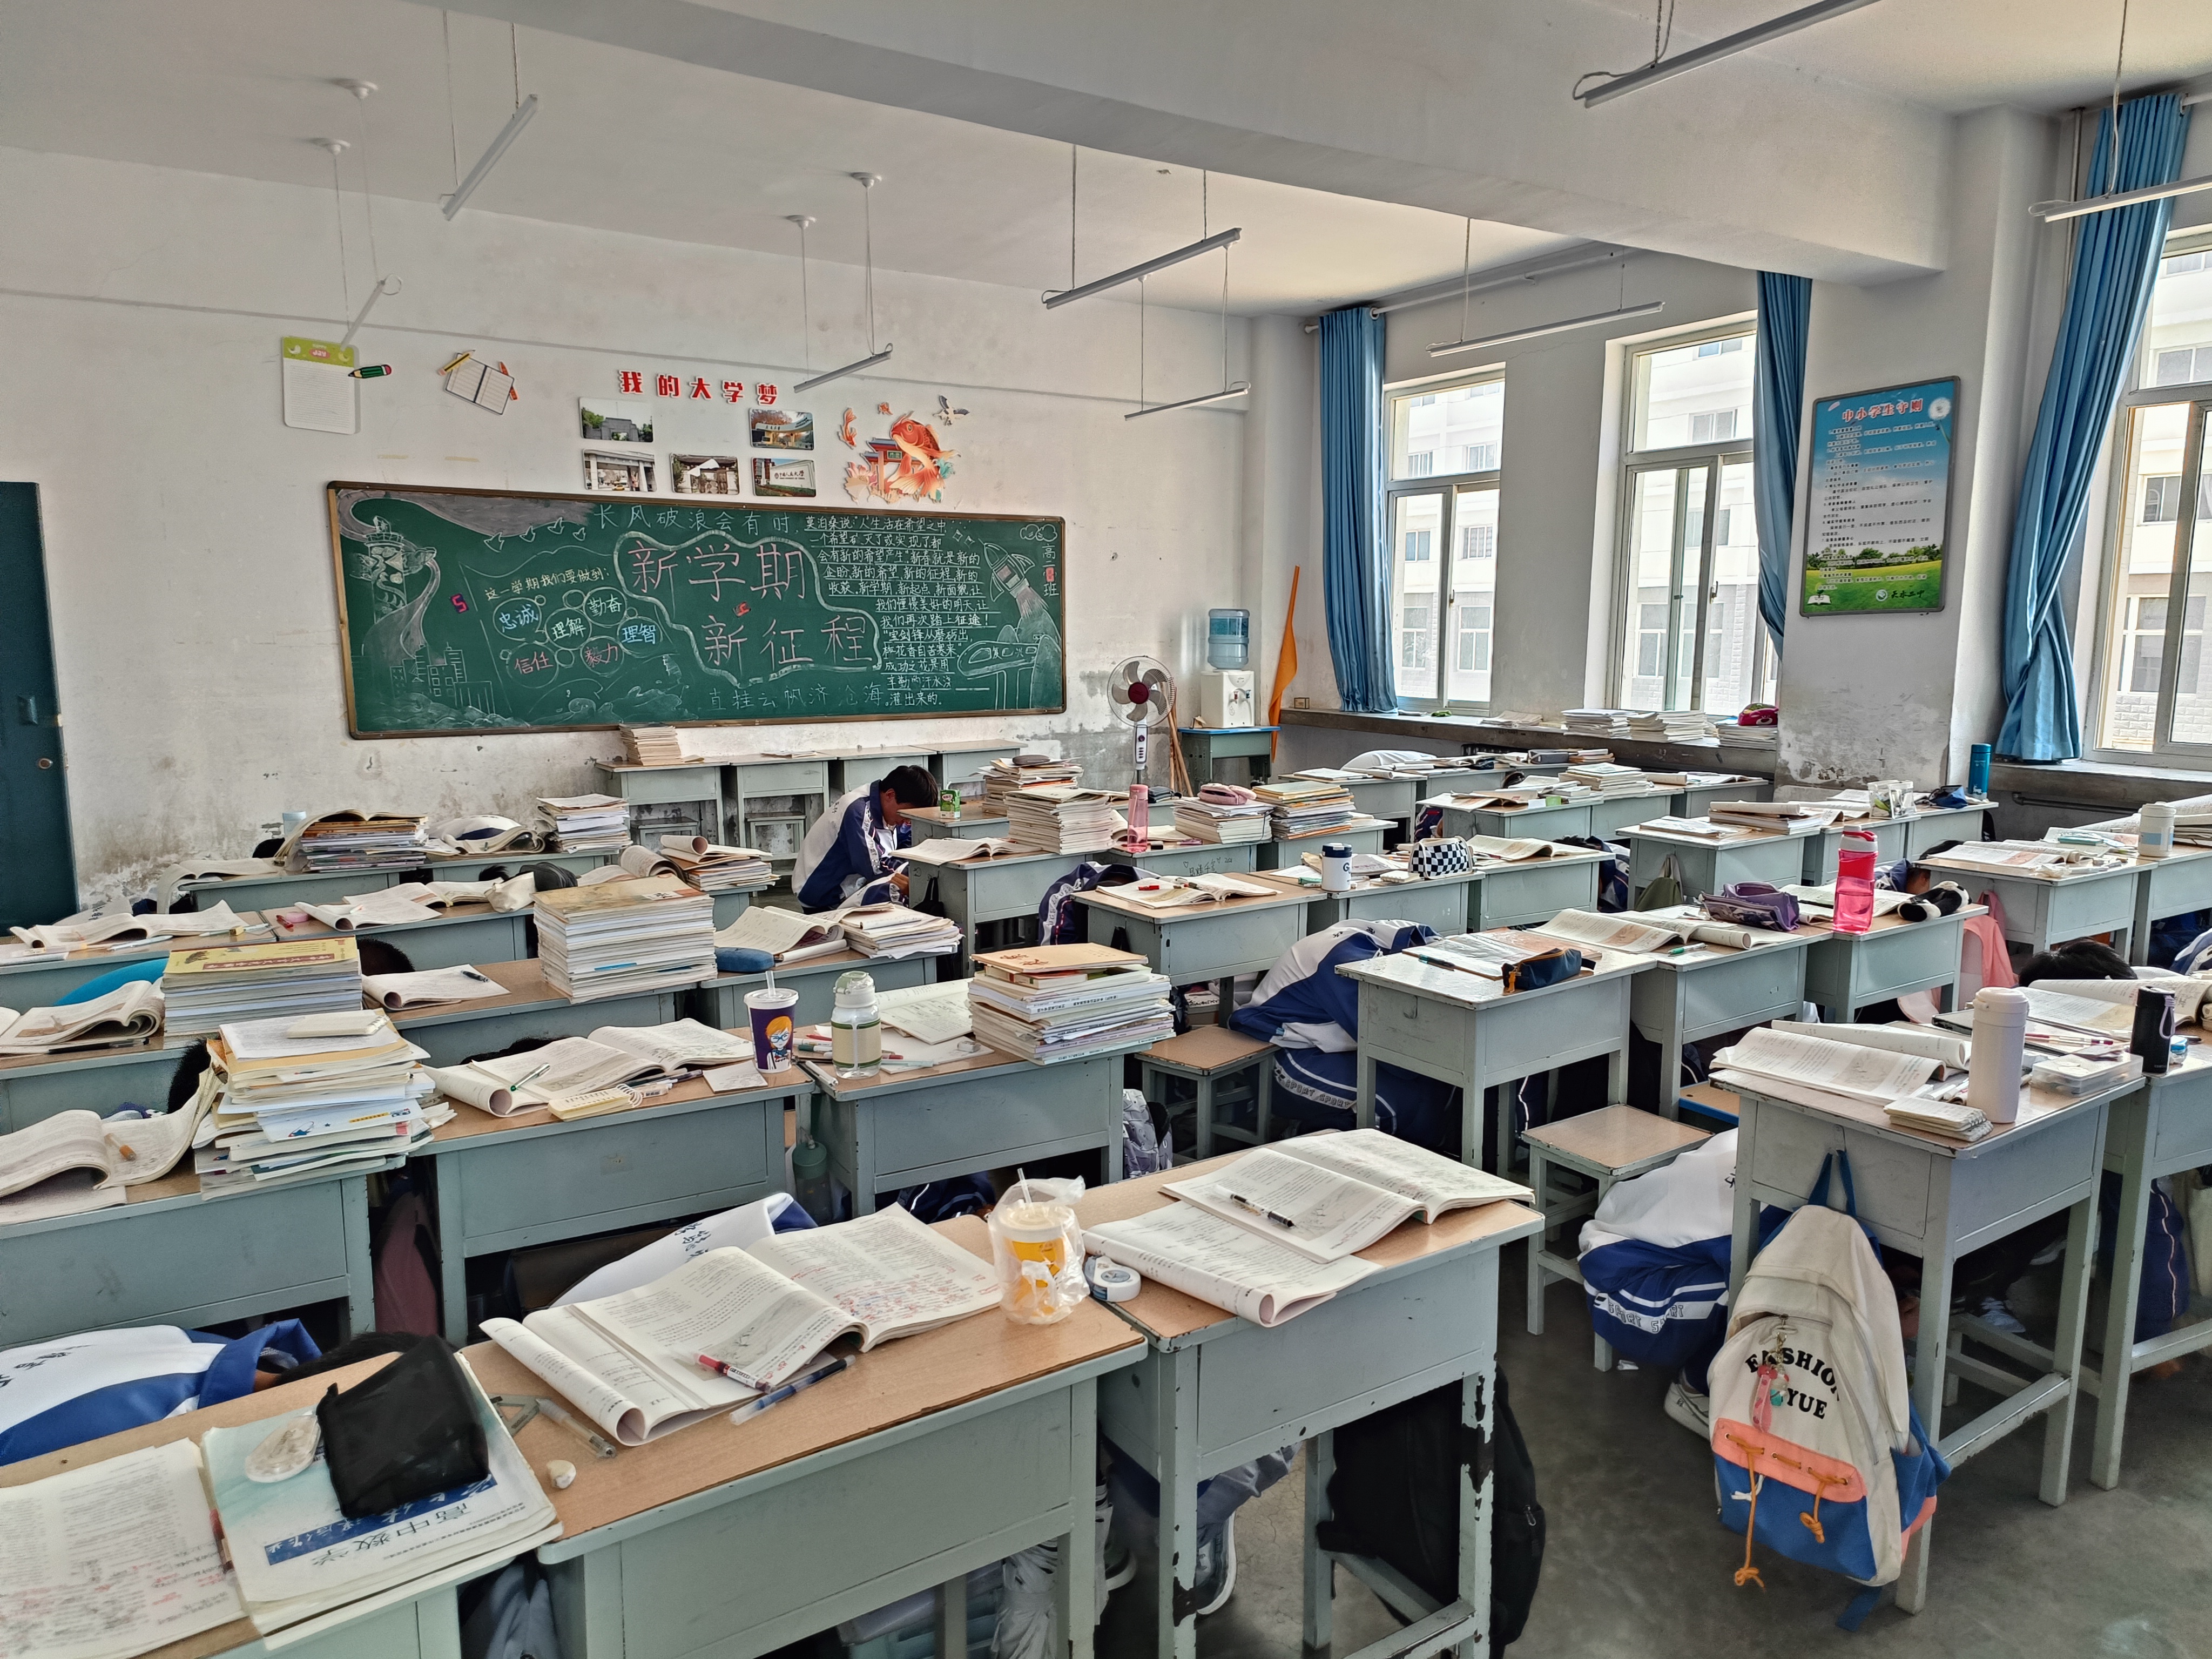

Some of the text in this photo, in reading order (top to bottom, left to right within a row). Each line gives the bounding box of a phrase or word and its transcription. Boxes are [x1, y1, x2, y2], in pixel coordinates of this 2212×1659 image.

[619, 370, 778, 405] 我的大学梦
[1842, 398, 1924, 423] 中小学生守则
[484, 567, 610, 601] 这一学期我们要做到：
[628, 540, 806, 619] 新学期
[588, 594, 623, 617] 勤奋
[1891, 589, 1925, 599] 天水二中
[498, 603, 539, 632] 忠诚
[551, 617, 587, 642] 理解
[622, 623, 657, 645] 理智
[702, 613, 873, 675] 新征程
[514, 651, 554, 675] 信任
[585, 643, 618, 668] 毅力
[885, 659, 949, 672] 成功之花是用
[887, 675, 952, 689] 辛勤的汗水浇
[1285, 1079, 1316, 1096] SPORT
[312, 1502, 471, 1567] 高中数学
